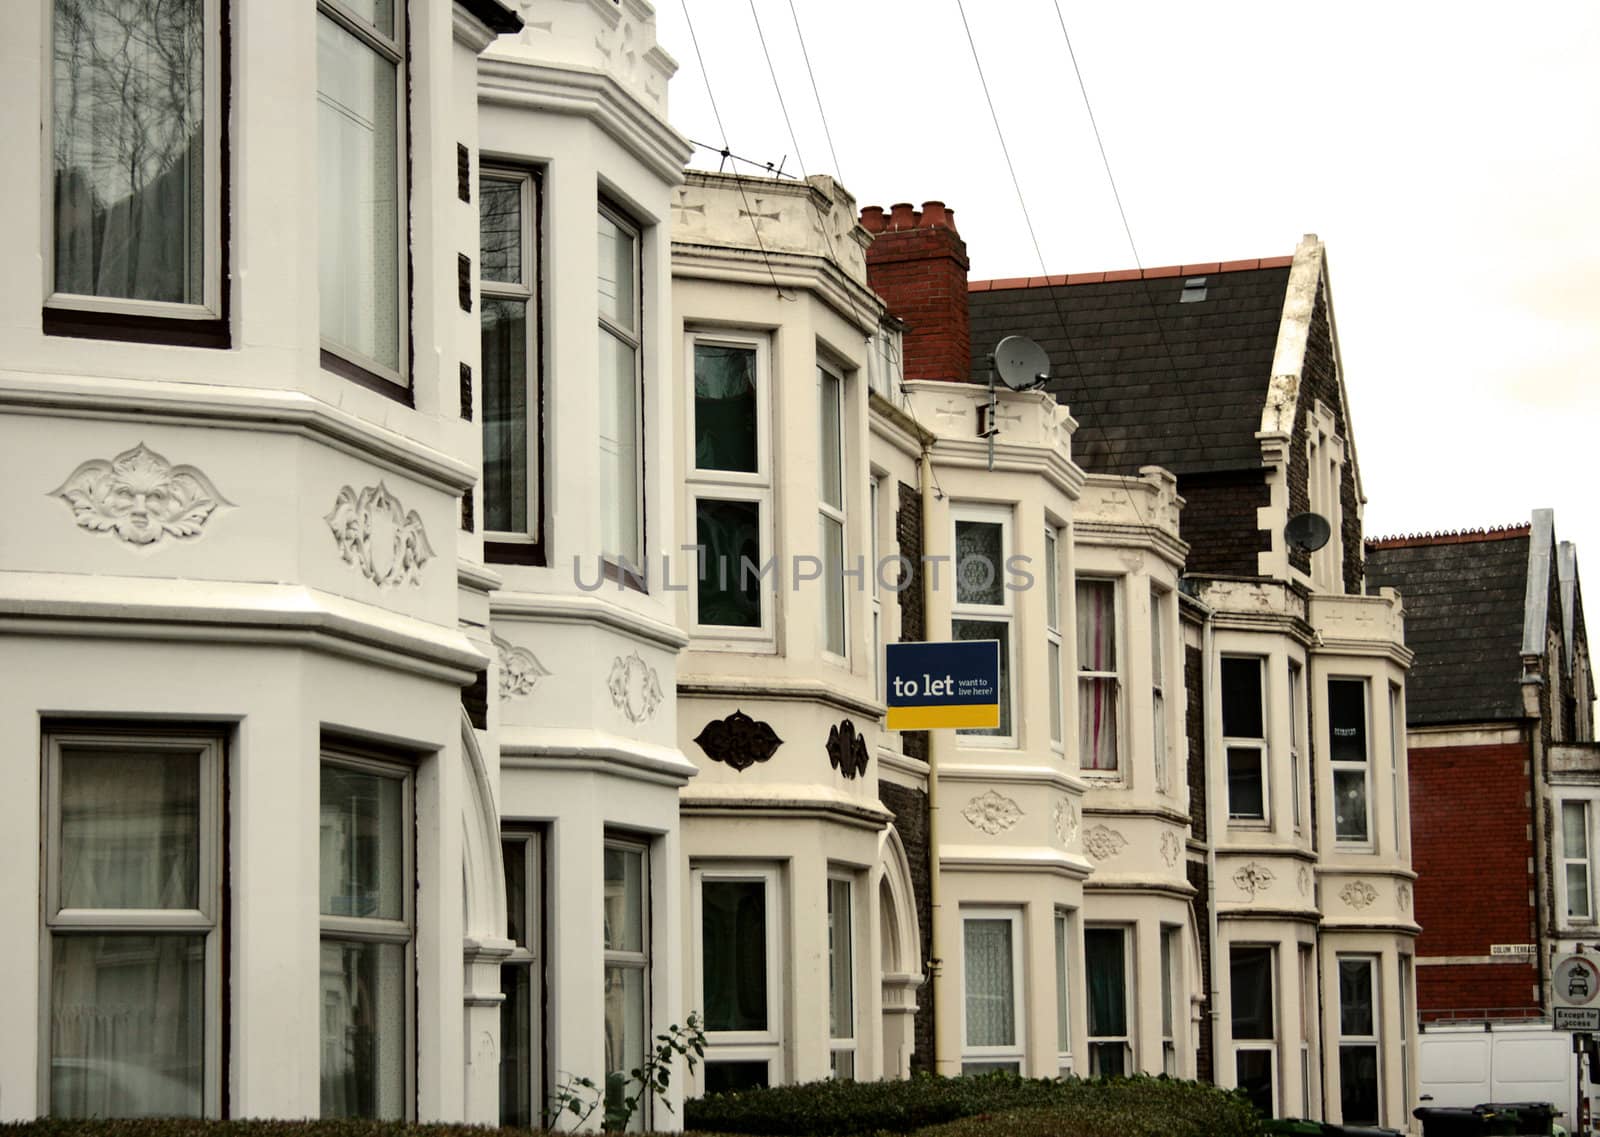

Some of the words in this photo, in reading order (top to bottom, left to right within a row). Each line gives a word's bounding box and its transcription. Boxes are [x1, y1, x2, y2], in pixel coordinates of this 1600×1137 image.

[893, 675, 918, 697] to
[923, 674, 954, 696] let
[979, 678, 987, 686] to
[958, 688, 972, 696] live
[973, 687, 993, 696] here?
[1558, 1011, 1585, 1019] Except
